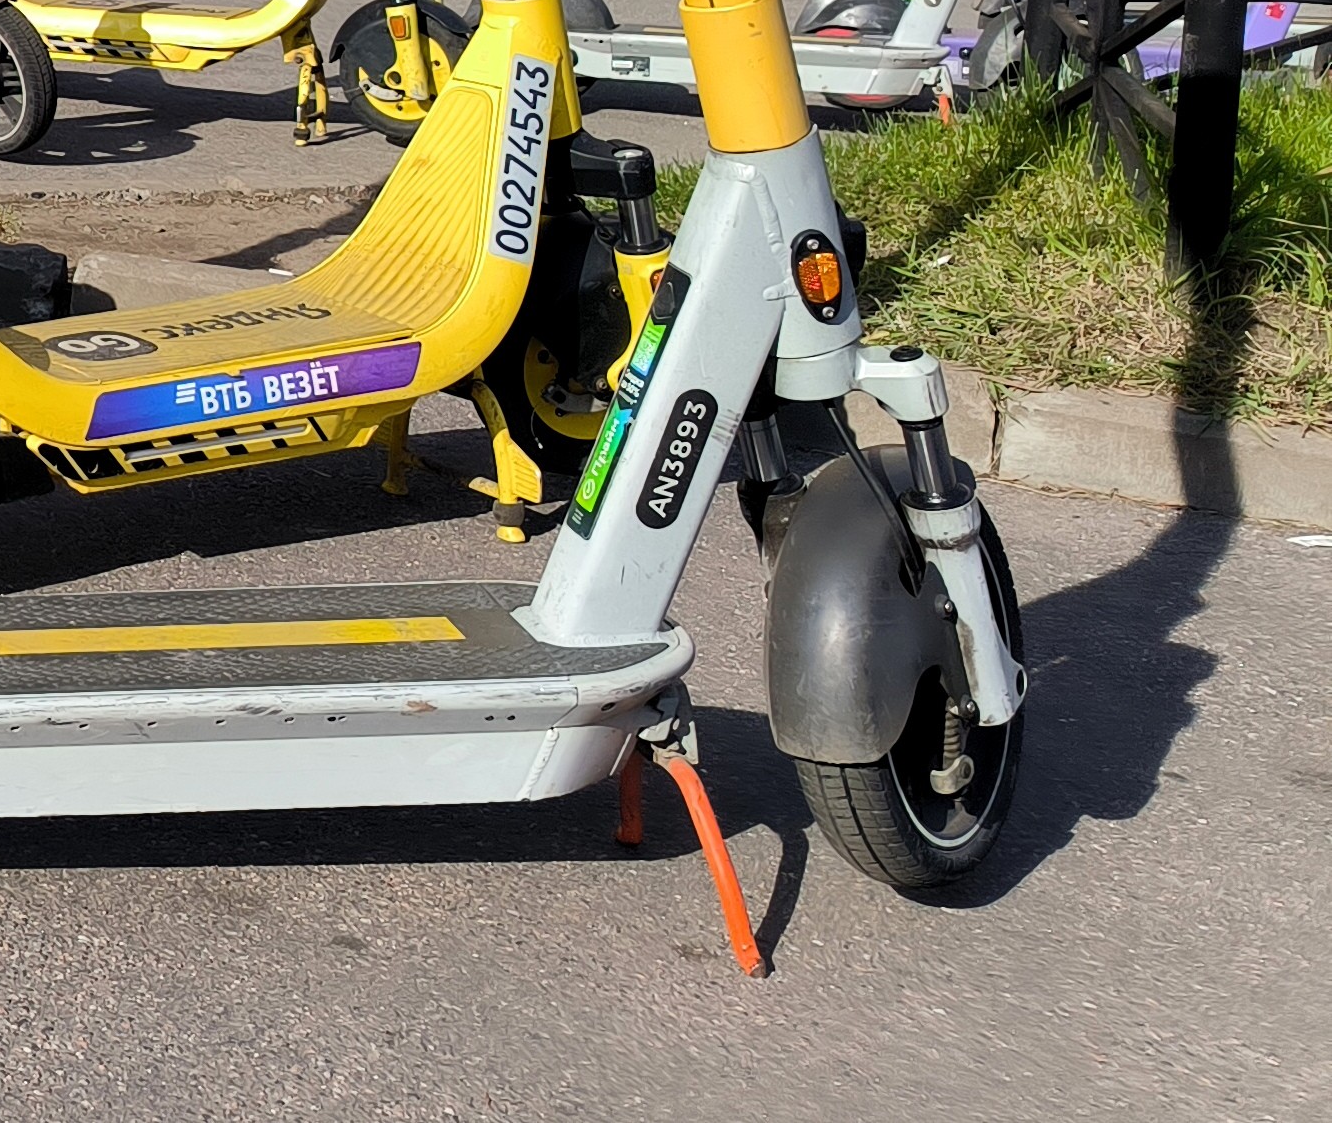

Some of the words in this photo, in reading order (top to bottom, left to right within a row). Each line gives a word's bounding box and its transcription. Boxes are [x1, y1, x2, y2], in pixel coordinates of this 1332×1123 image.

[495, 60, 550, 255] 00274543
[141, 302, 332, 340] Яндекс
[200, 379, 253, 415] ВТБ
[263, 361, 340, 404] ВЕЗЁТ
[648, 400, 707, 519] AN3893
